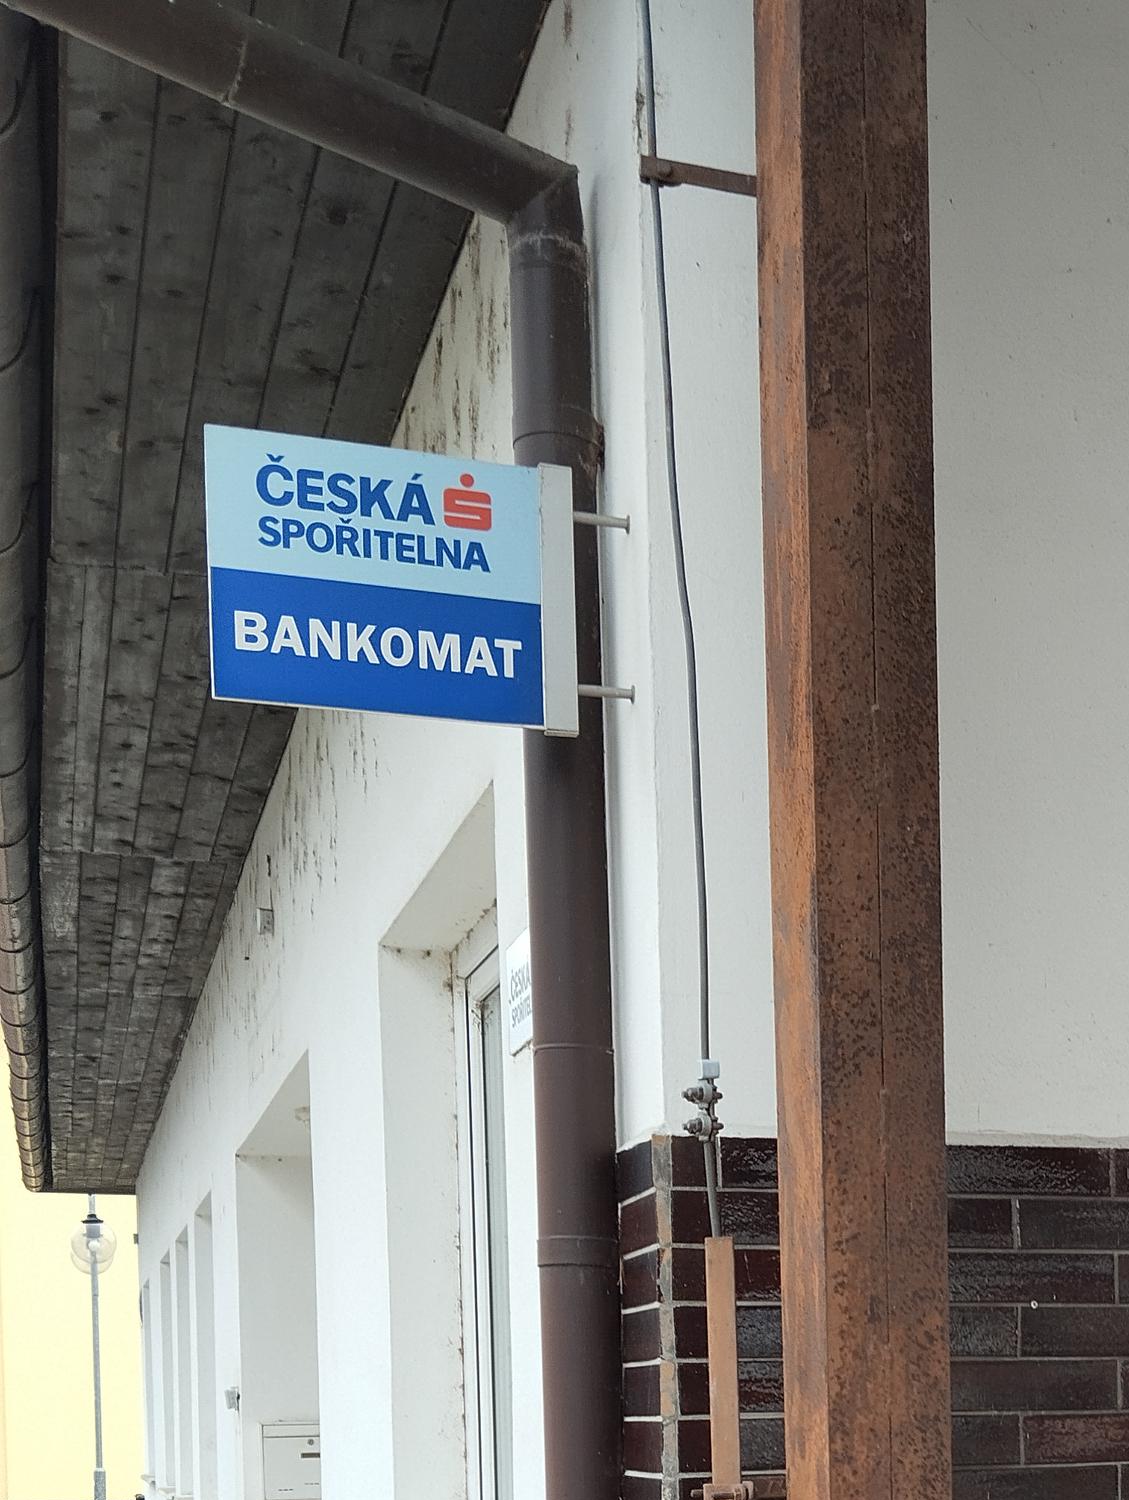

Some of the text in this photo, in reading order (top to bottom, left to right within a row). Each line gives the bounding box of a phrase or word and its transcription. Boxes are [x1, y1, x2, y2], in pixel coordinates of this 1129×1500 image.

[256, 453, 435, 526] ČESKÁ
[258, 516, 491, 573] SPOŘITELNA
[233, 610, 523, 679] BANKOMAT
